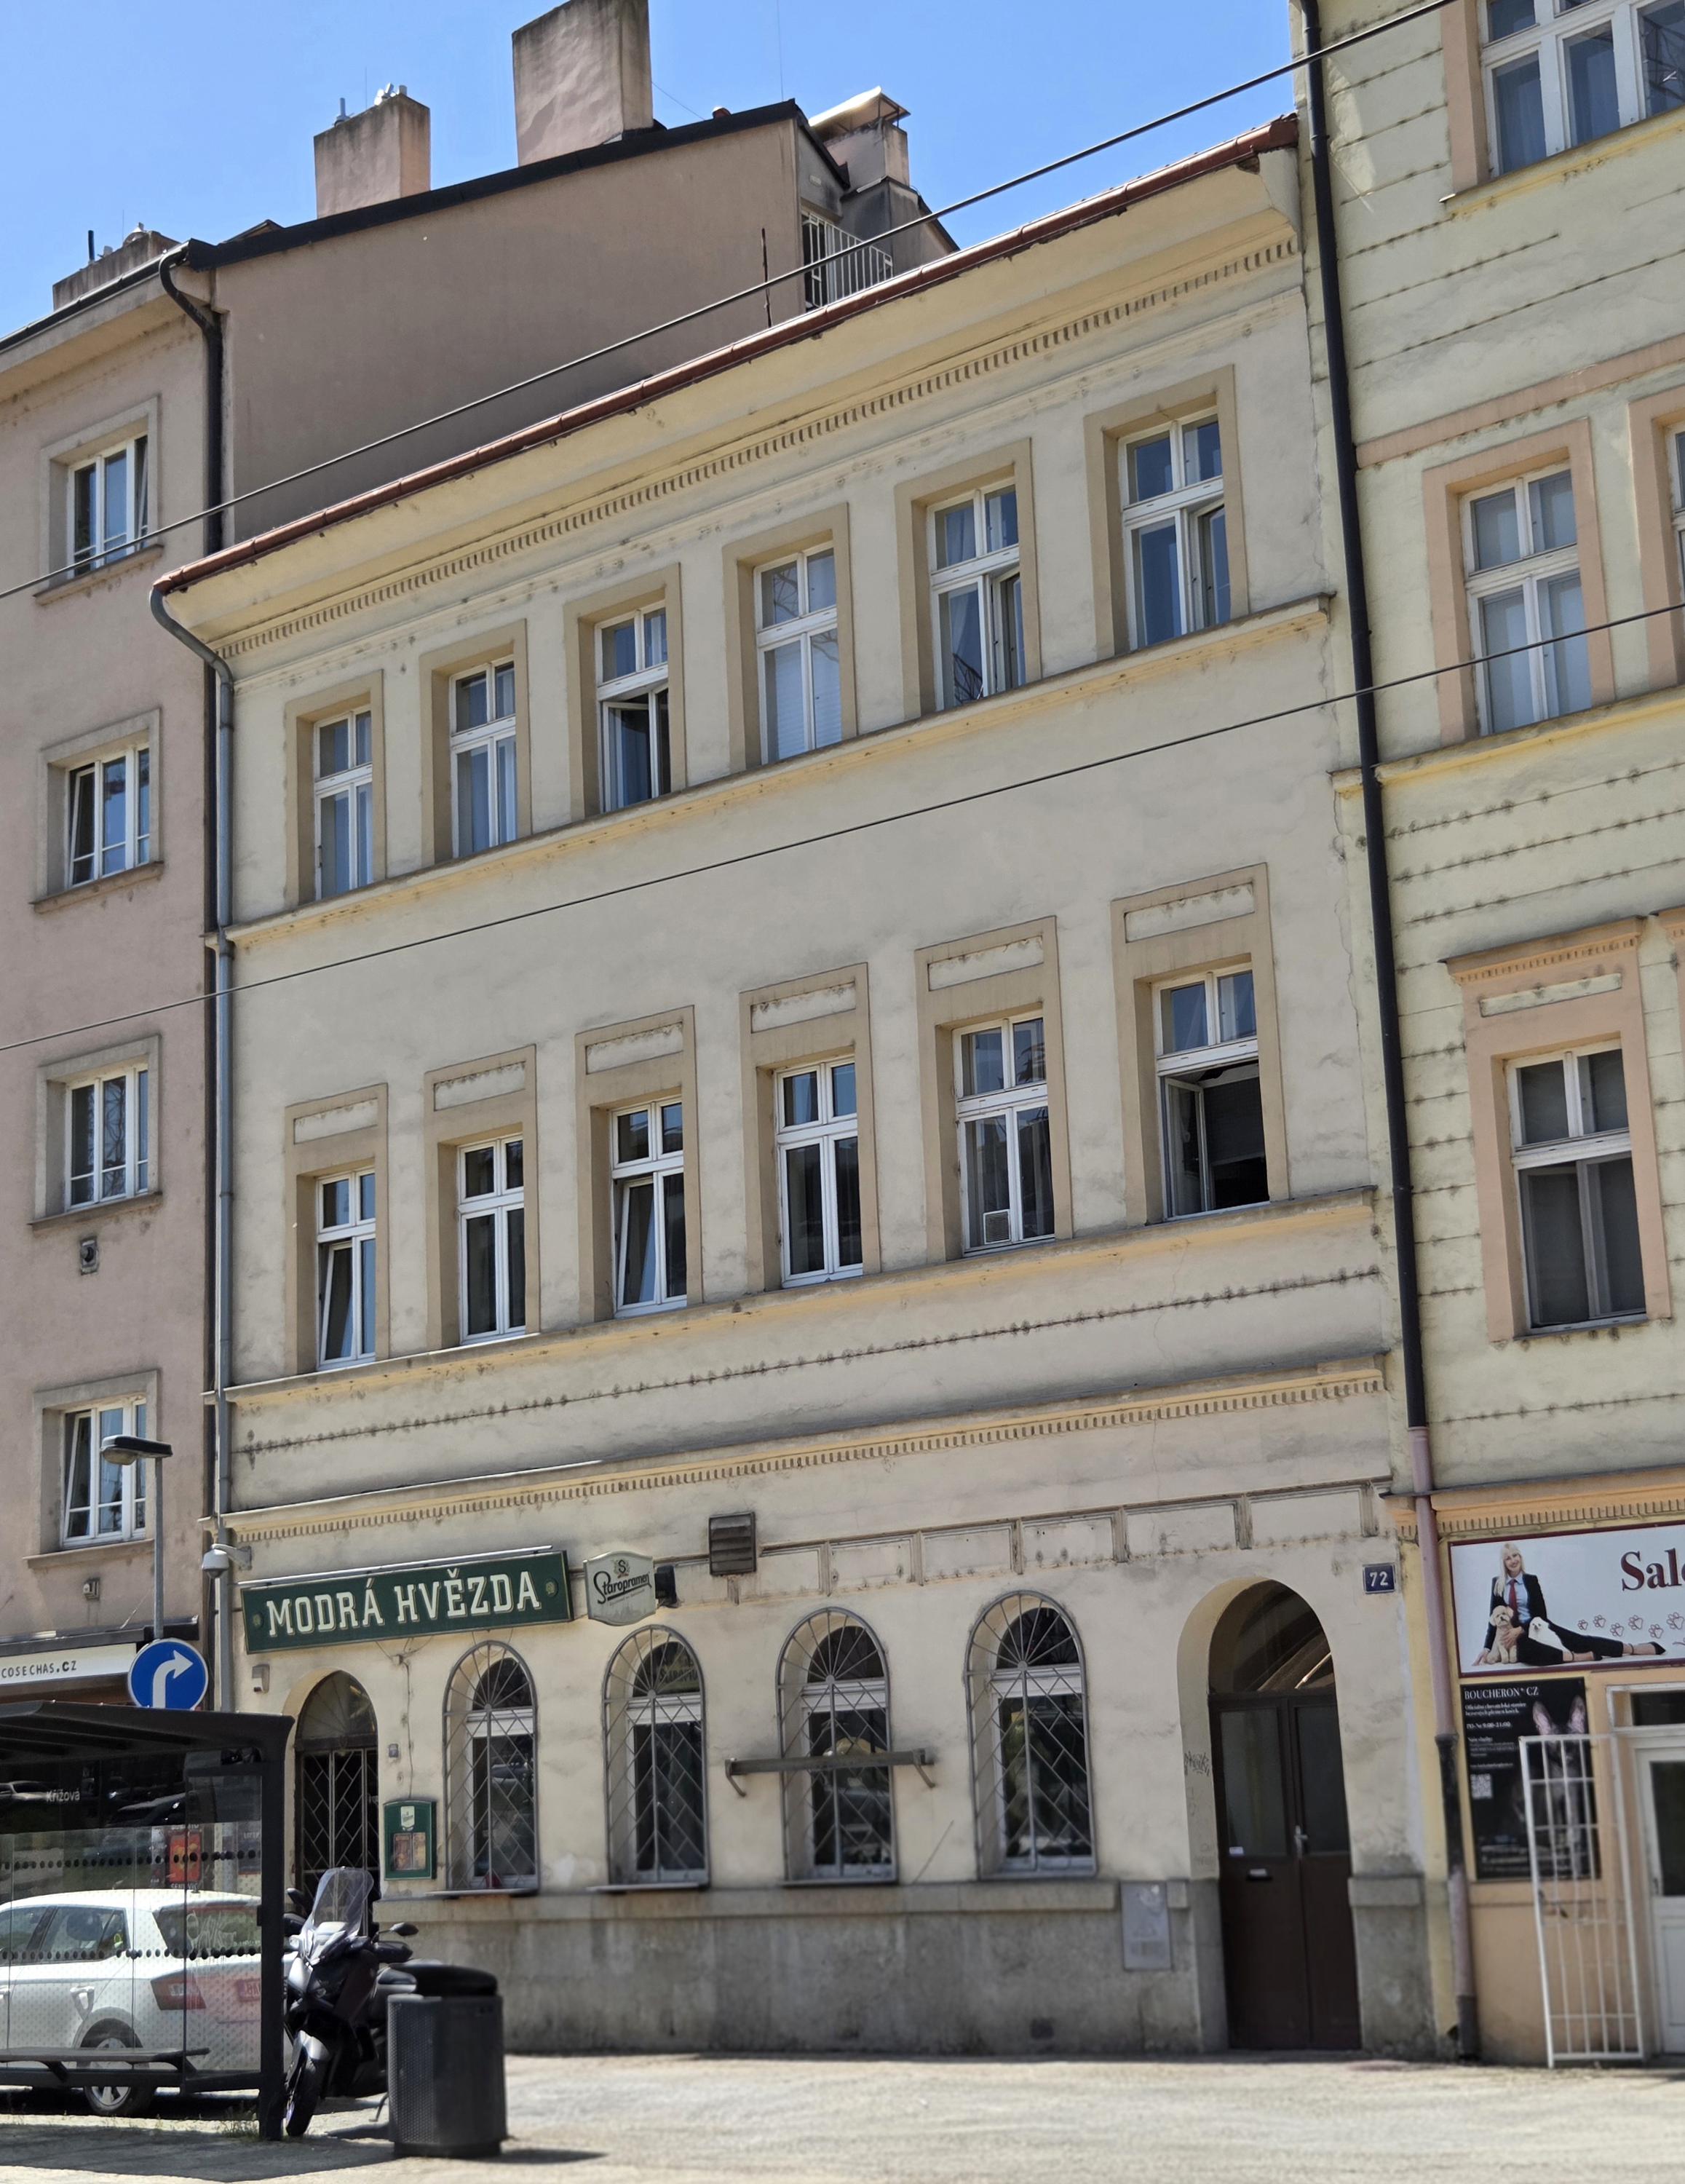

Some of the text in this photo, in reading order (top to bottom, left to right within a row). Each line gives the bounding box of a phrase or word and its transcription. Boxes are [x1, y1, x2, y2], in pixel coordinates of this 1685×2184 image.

[1620, 1548, 1685, 1591] Sal
[593, 1570, 651, 1605] Staropramen
[1369, 1571, 1389, 1587] 72
[266, 1568, 542, 1637] MODRÁ HVĚZDA
[1, 1661, 77, 1679] COSECHAS.CZ
[1526, 1686, 1539, 1696] CZ
[46, 1788, 80, 1802] Křížová
